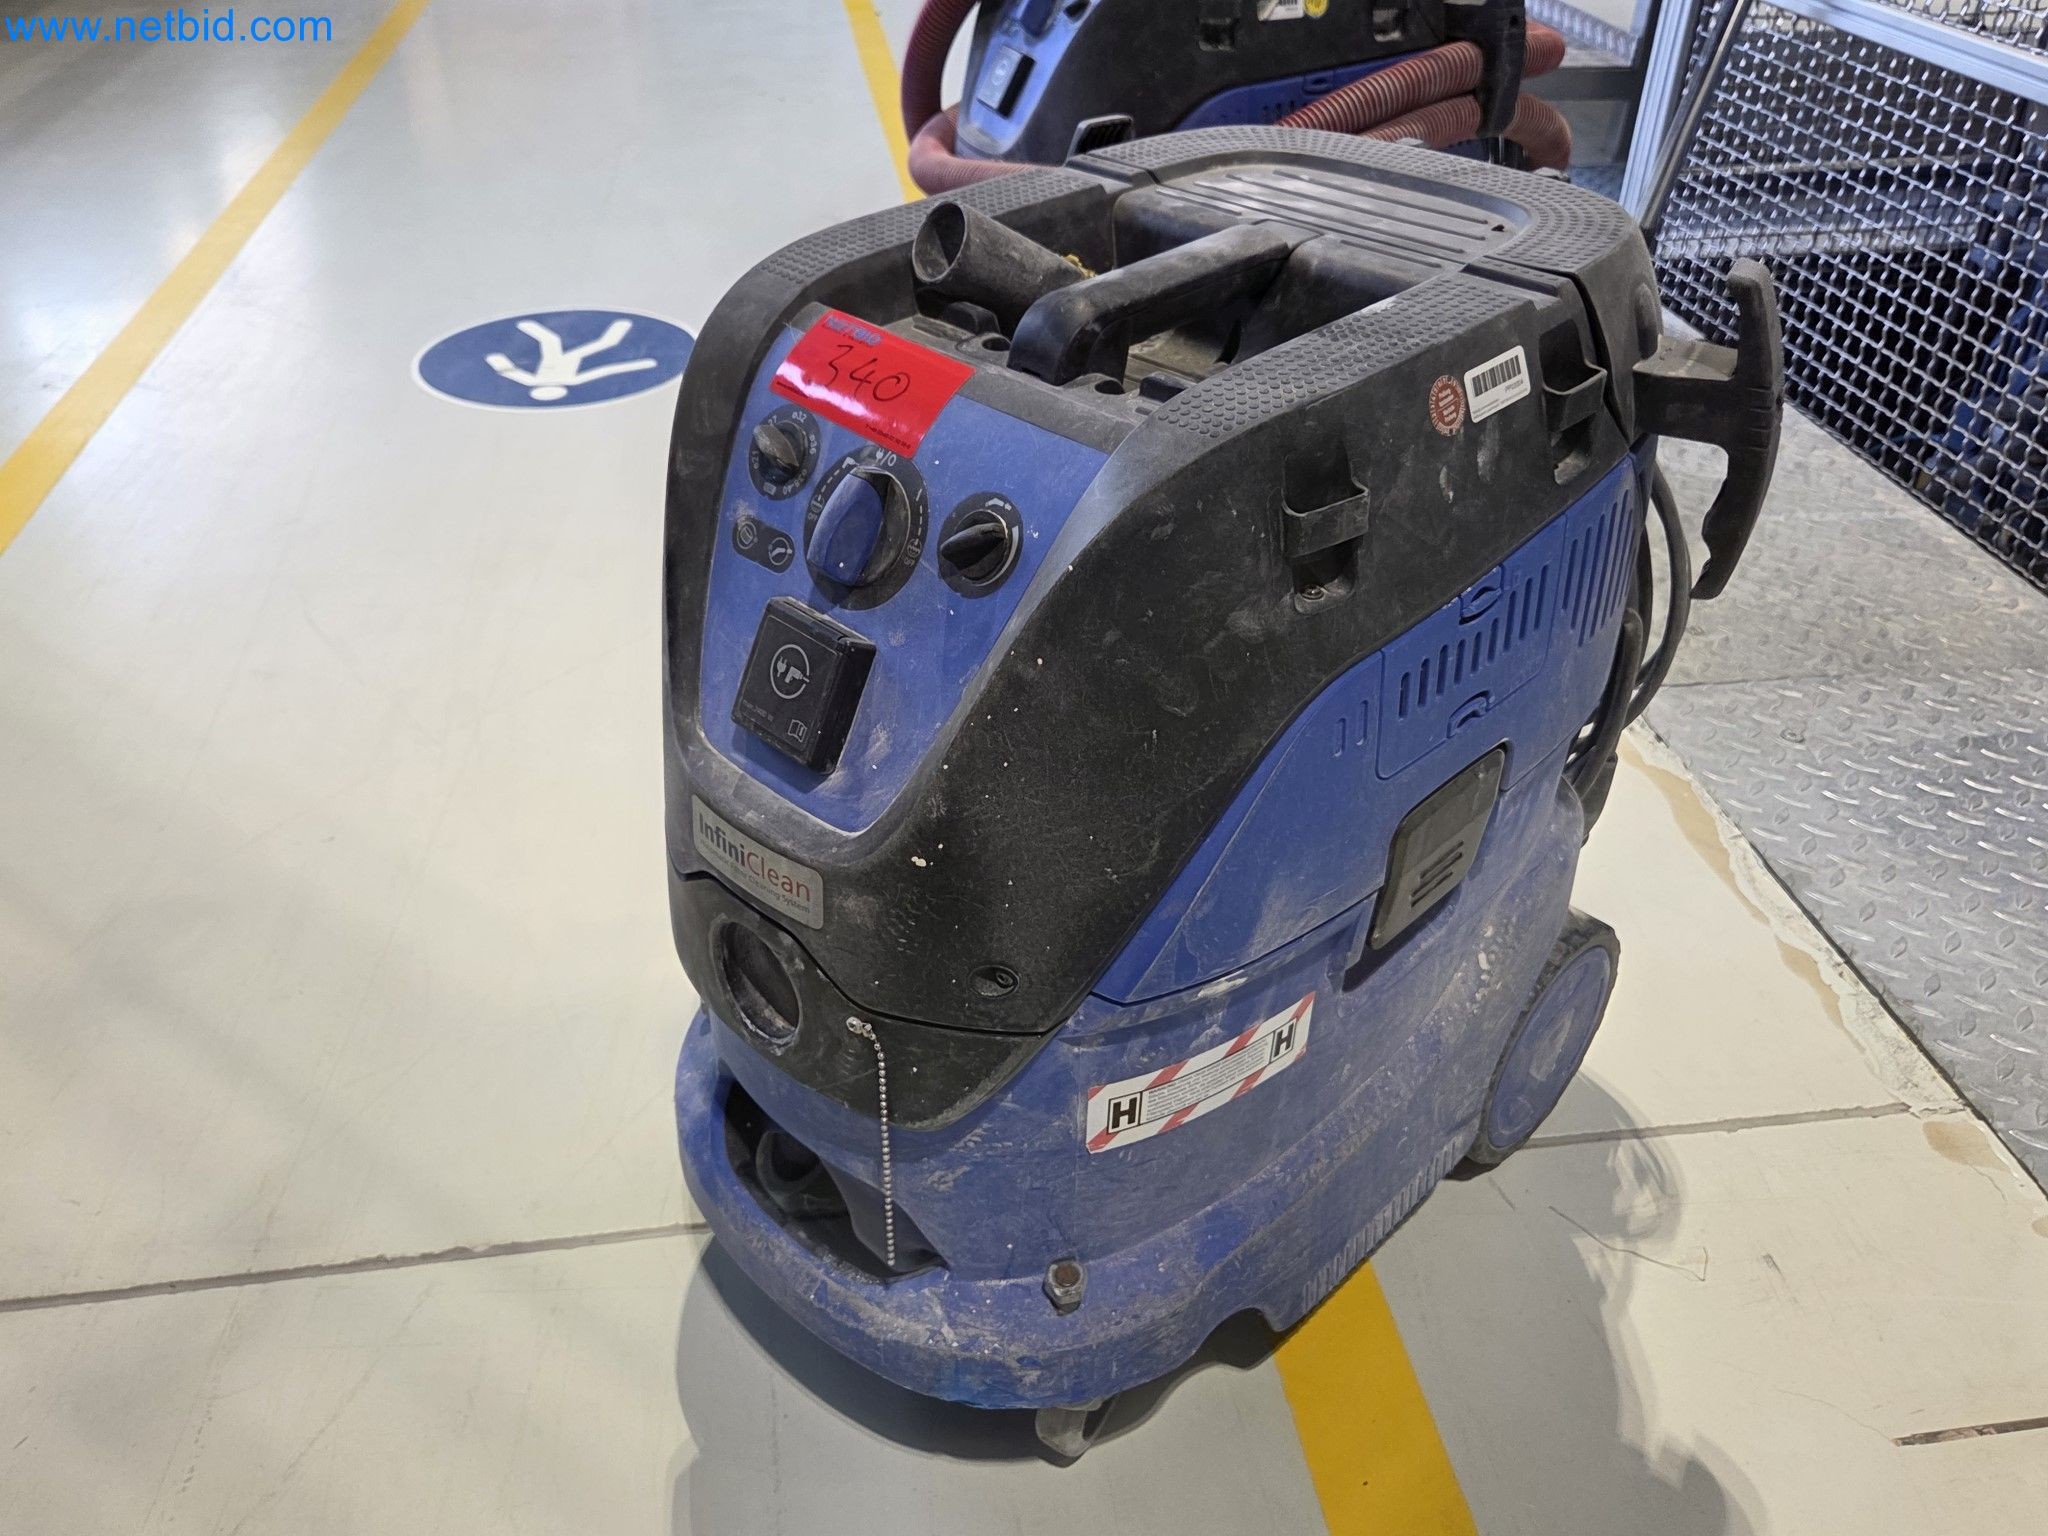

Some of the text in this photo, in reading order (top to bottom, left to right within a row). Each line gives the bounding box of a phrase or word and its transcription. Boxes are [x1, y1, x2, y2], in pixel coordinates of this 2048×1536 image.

[827, 344, 911, 402] 340
[698, 812, 811, 903] InfiniClean
[1274, 1023, 1295, 1058] H
[1111, 1096, 1138, 1130] H
